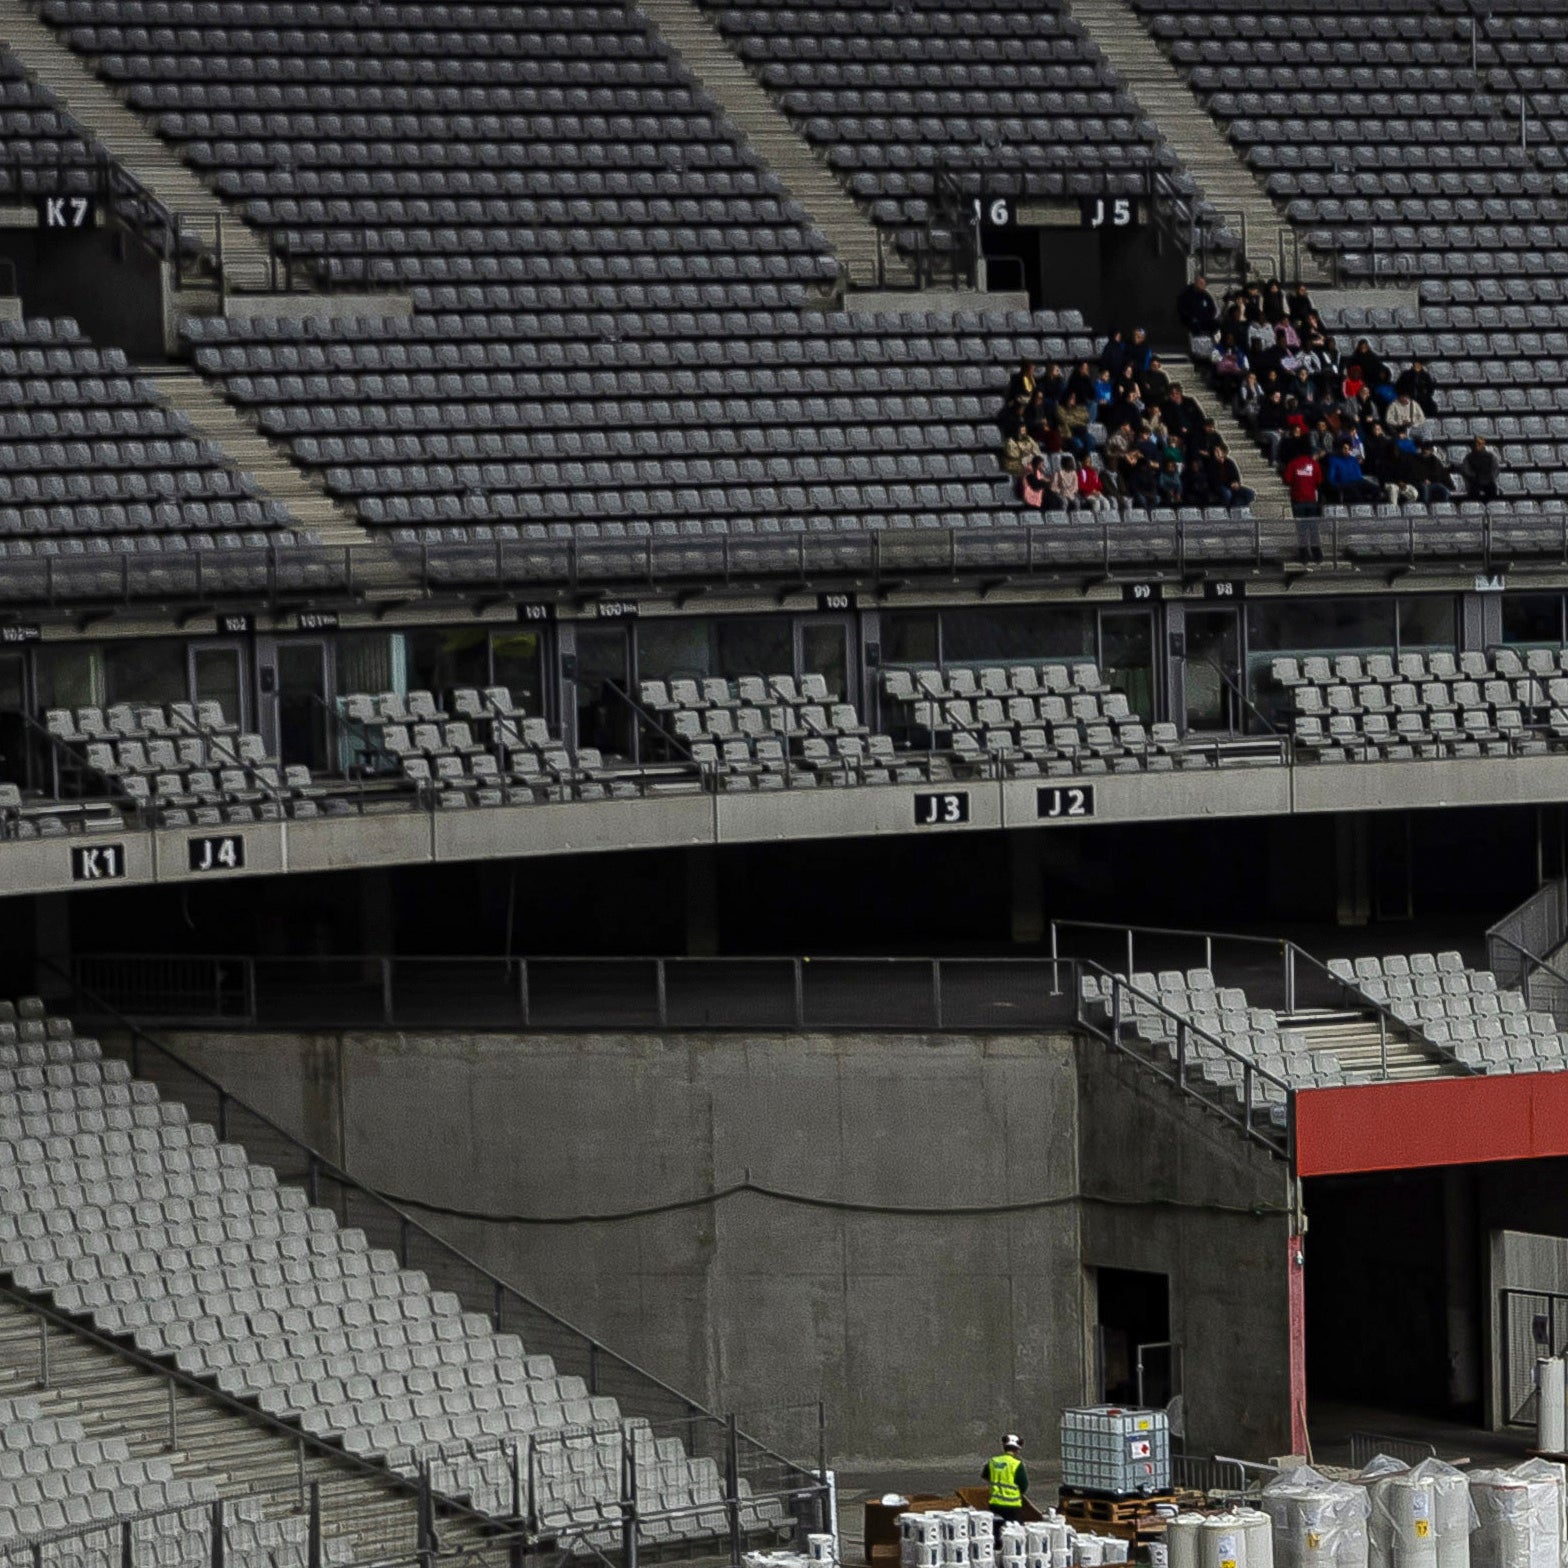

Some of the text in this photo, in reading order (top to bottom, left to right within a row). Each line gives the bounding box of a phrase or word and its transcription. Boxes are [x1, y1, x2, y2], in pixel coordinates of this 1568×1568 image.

[46, 197, 88, 227] K7
[1091, 198, 1131, 228] J5
[926, 796, 961, 823] J3
[1048, 788, 1085, 817] J2
[83, 848, 116, 879] K1
[199, 838, 237, 869] J4
